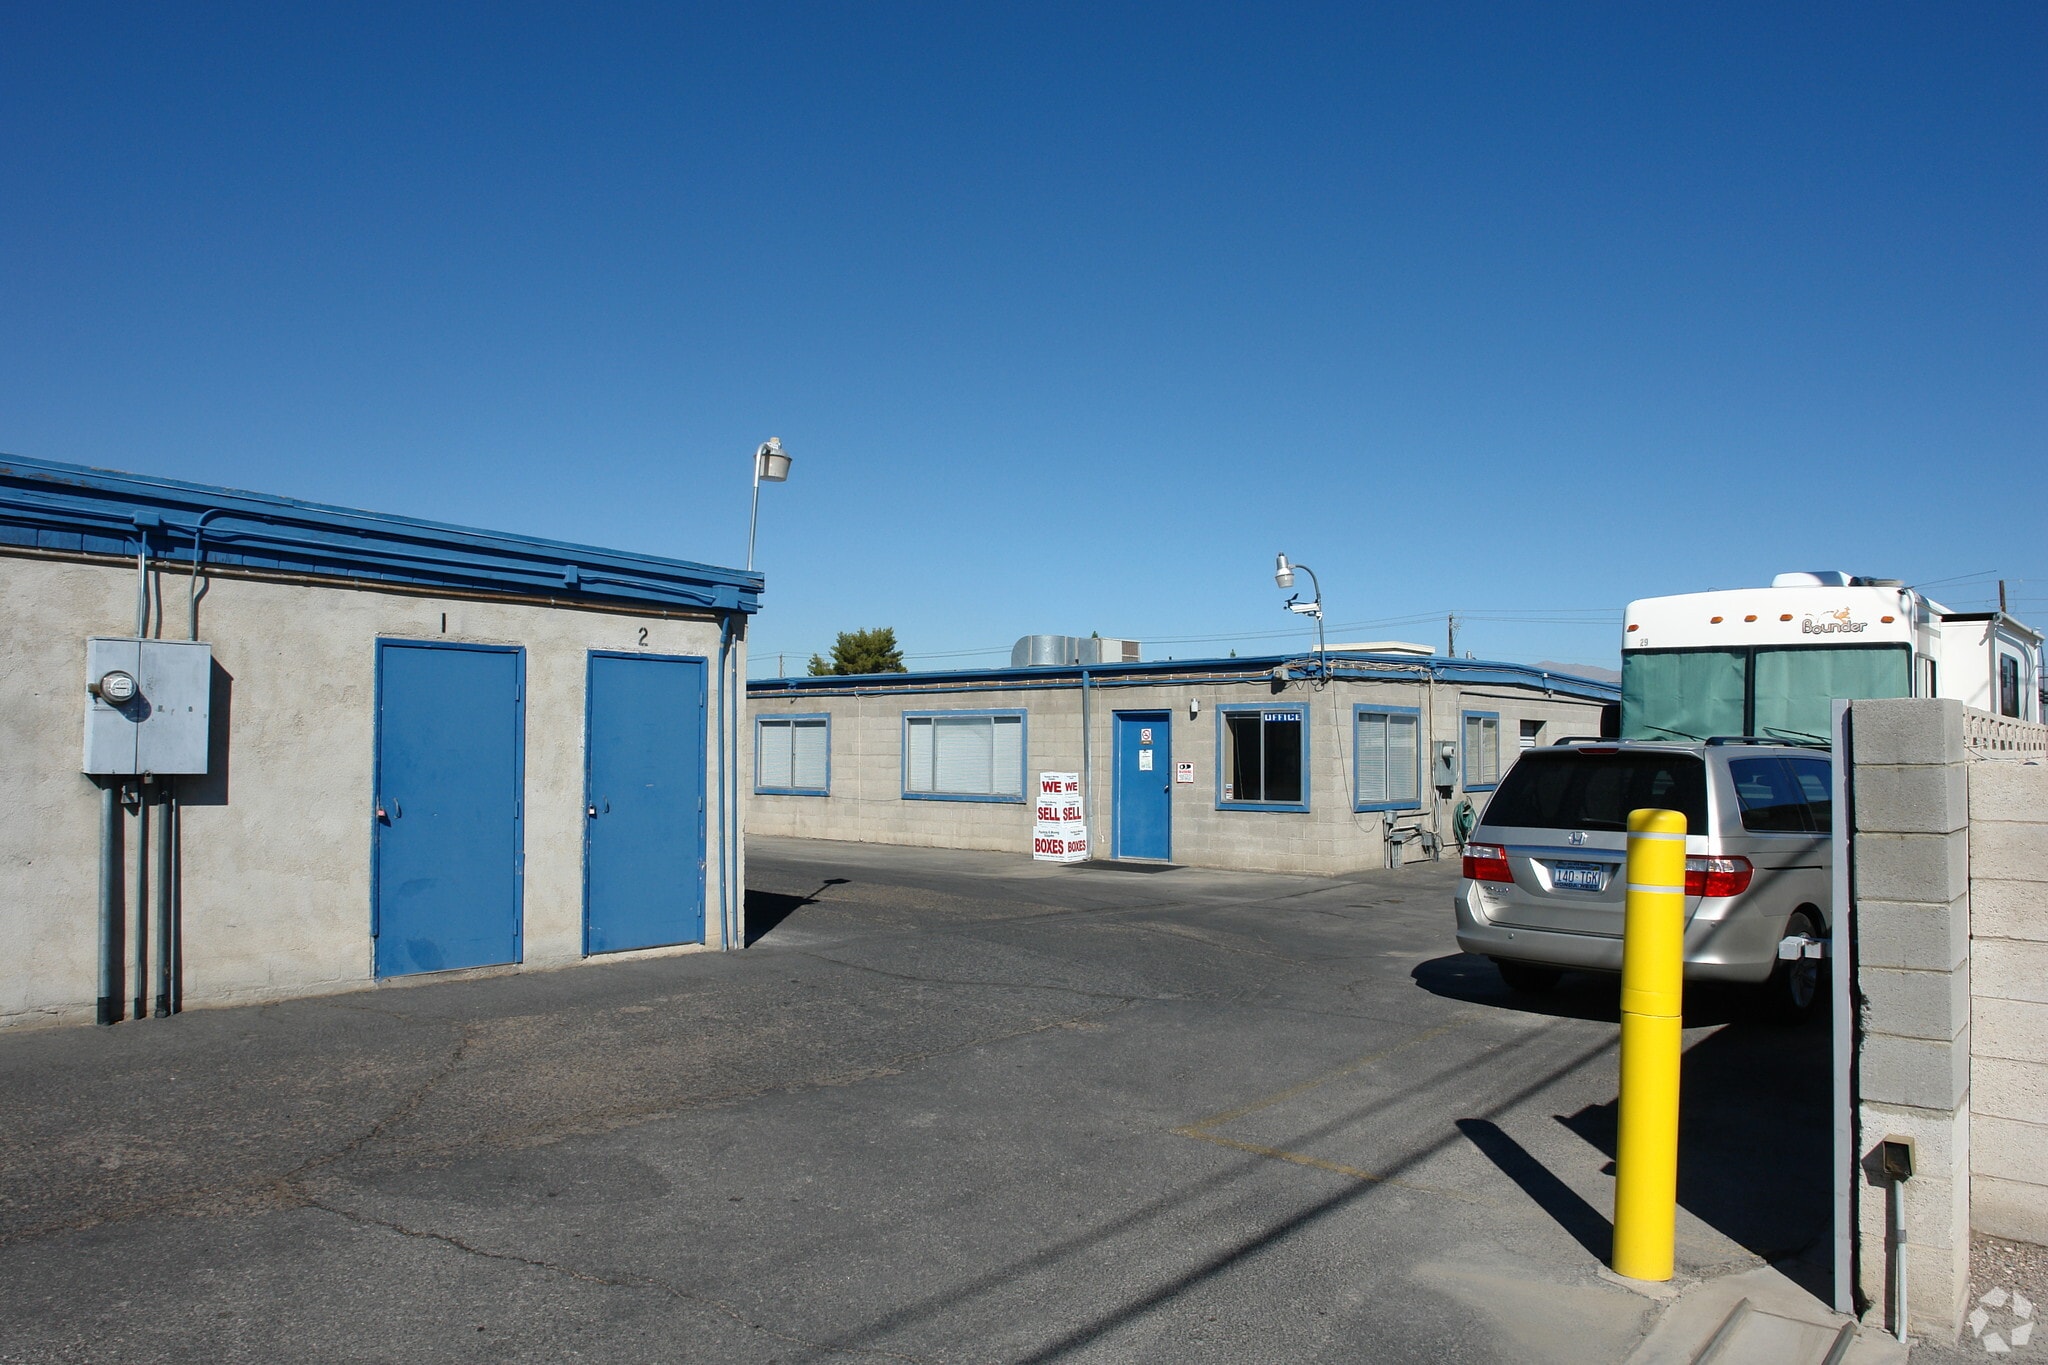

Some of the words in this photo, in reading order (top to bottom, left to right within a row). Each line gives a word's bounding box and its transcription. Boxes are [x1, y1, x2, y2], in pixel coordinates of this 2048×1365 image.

[1802, 618, 1868, 634] Bounder
[638, 627, 649, 647] 2
[1639, 638, 1649, 647] 29
[1264, 713, 1302, 721] OFFICE
[1042, 781, 1062, 793] WE
[1065, 782, 1078, 792] WE
[1037, 807, 1060, 821] SELL
[1062, 807, 1082, 821] SELL
[1035, 838, 1064, 855] BOXES
[1067, 840, 1086, 853] BOXES
